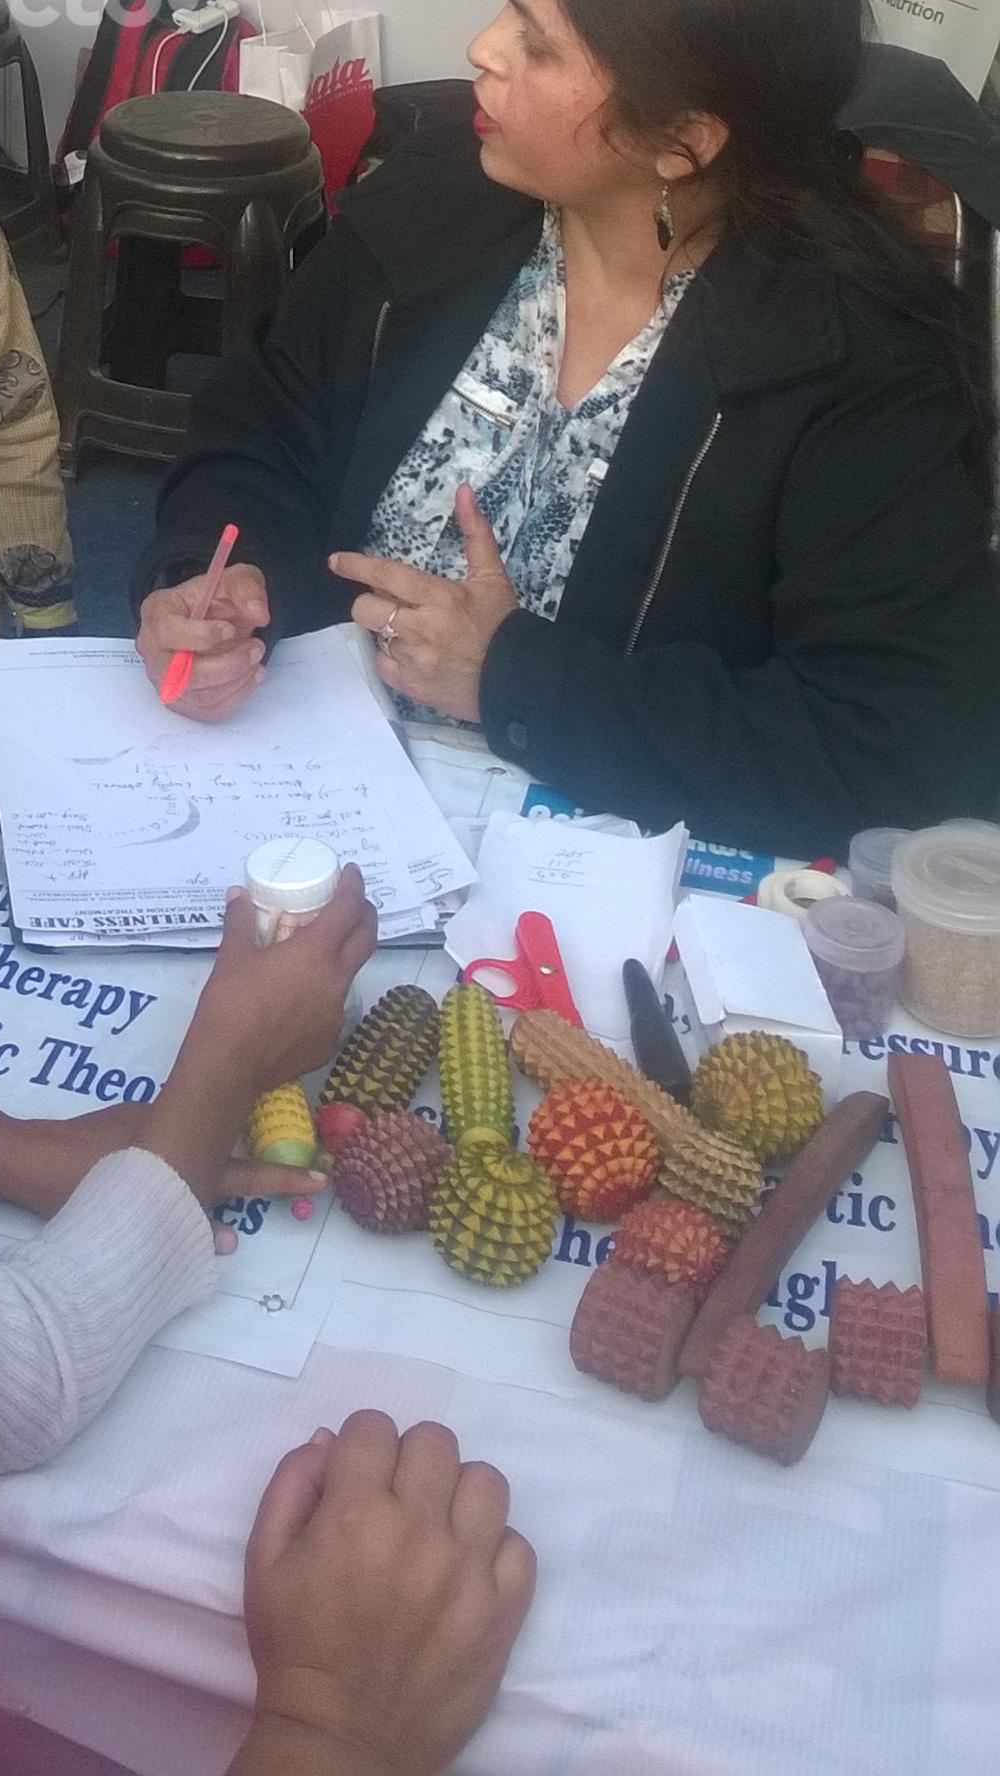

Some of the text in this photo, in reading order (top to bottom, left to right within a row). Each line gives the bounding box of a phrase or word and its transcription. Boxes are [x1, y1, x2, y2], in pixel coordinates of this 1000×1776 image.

[28, 916, 85, 929] CAFE
[92, 912, 209, 929] WELLNESS
[29, 1035, 166, 1108] Theo
